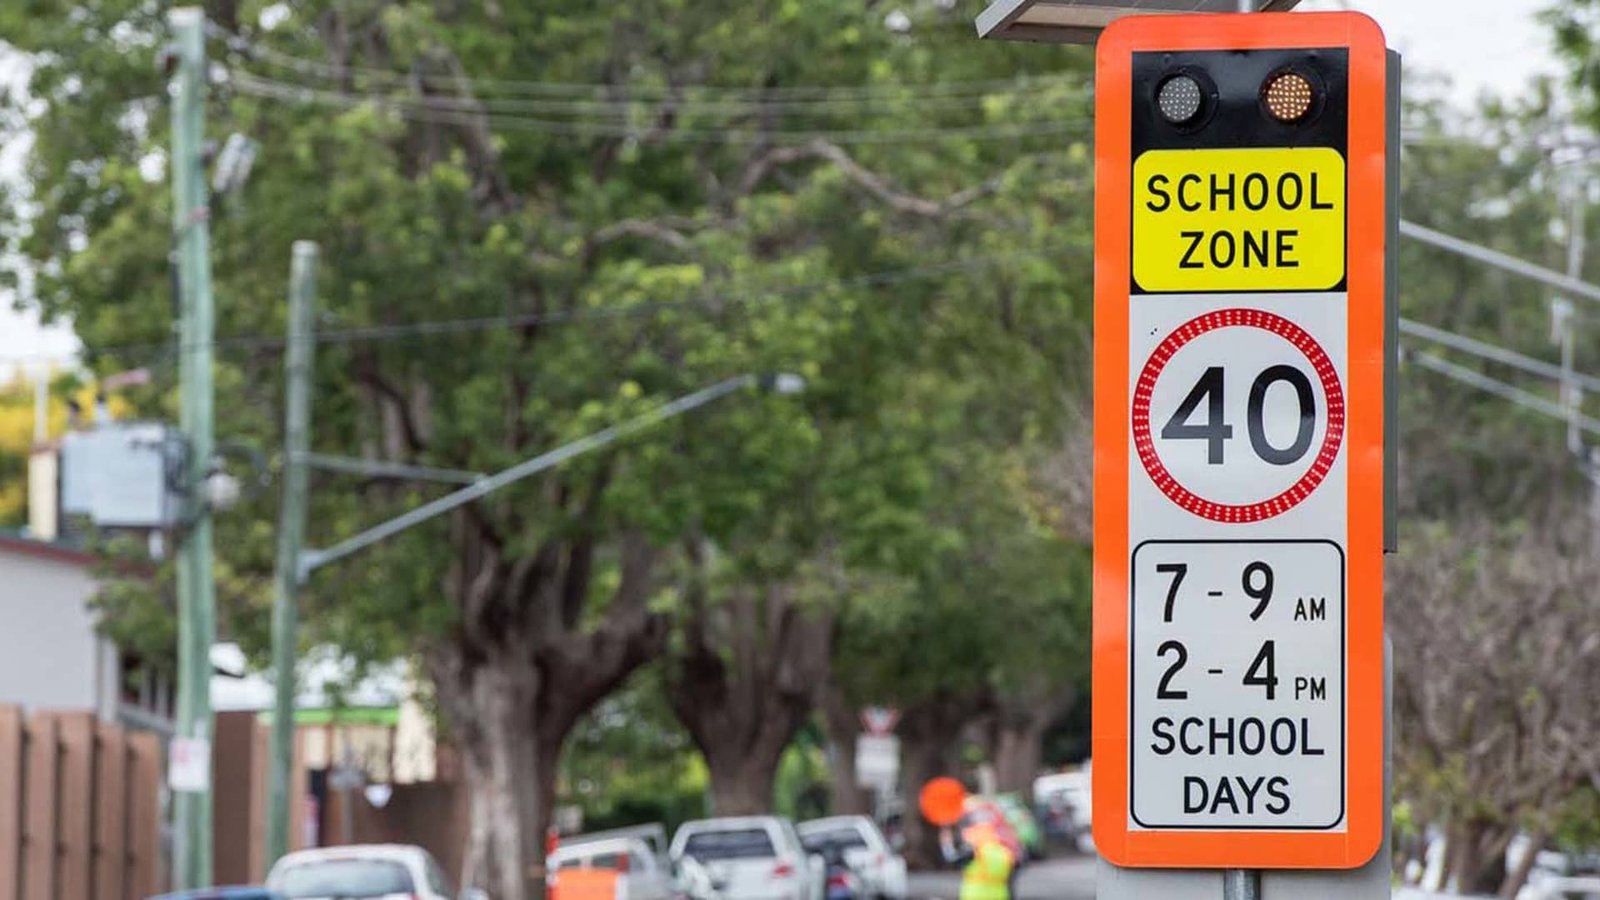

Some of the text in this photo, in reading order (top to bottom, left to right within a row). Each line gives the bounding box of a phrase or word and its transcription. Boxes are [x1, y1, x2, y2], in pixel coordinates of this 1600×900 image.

[1146, 172, 1334, 213] SCHOOL
[1178, 229, 1299, 269] ZONE
[1161, 364, 1316, 467] 40
[1156, 563, 1188, 623] 7
[1241, 560, 1274, 622] 9
[1294, 597, 1326, 621] AM
[1156, 640, 1188, 700] 2
[1242, 639, 1279, 701] 4
[1295, 676, 1326, 701] PM
[1150, 716, 1325, 756] SCHOOL
[1183, 776, 1291, 815] DAYS
